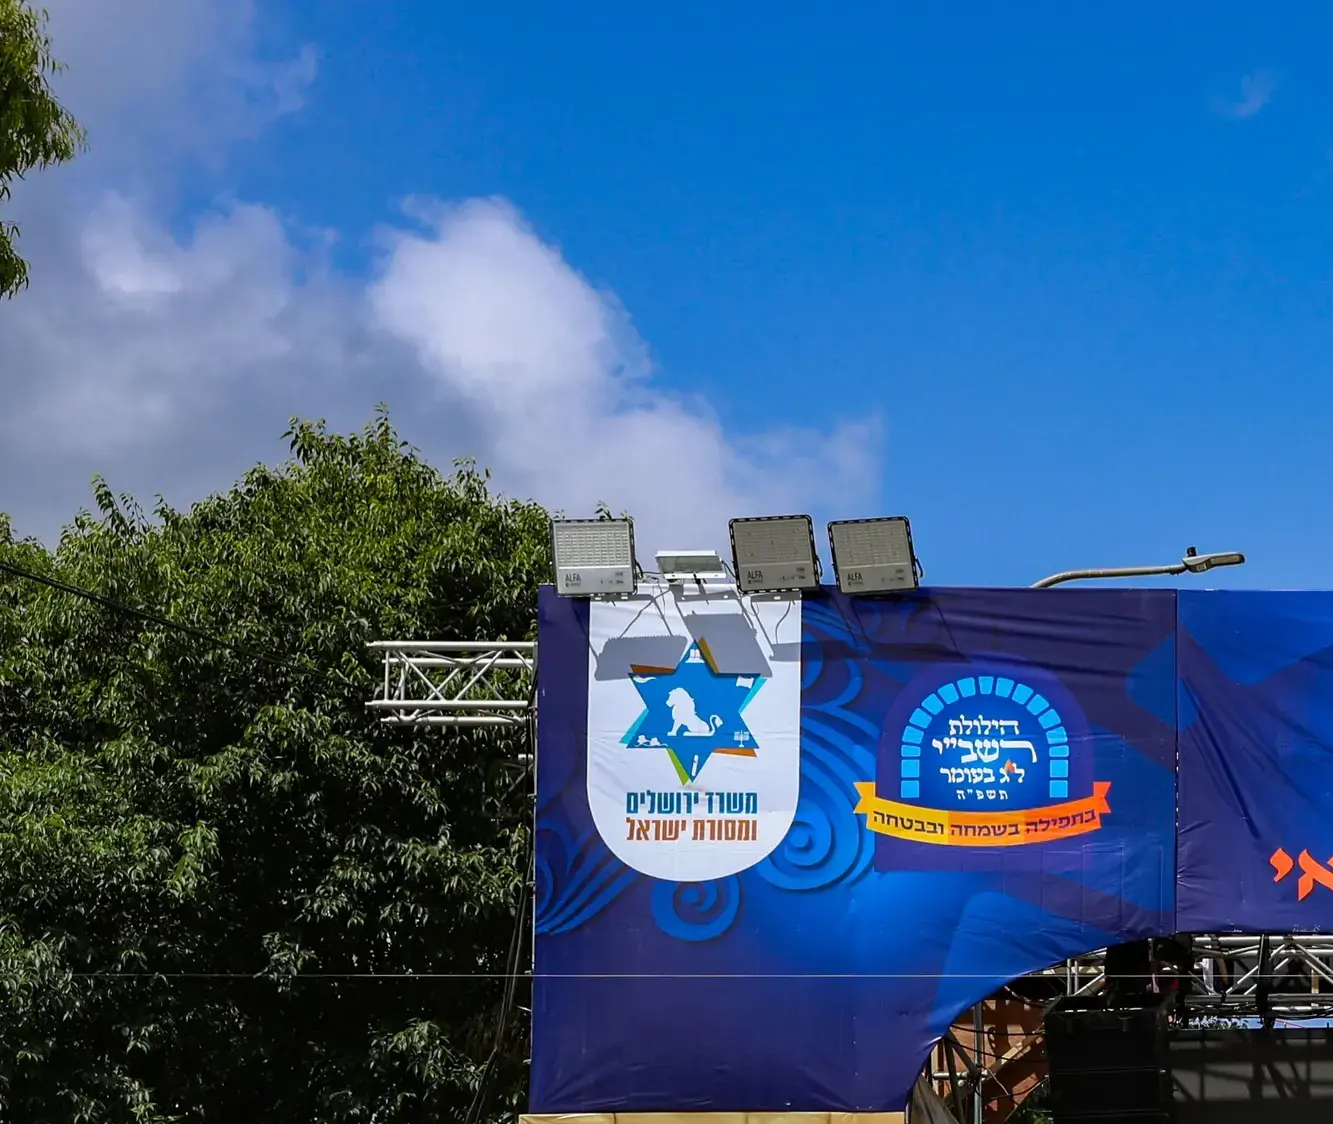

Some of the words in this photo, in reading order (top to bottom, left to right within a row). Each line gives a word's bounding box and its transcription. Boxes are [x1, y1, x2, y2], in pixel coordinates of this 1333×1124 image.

[949, 714, 1019, 738] הילולת
[939, 766, 995, 784] בעומר
[626, 790, 700, 815] ירושלים
[704, 791, 758, 814] משרד
[626, 817, 687, 843] ישראל
[691, 817, 757, 842] ומסורת
[872, 808, 944, 836] ובבטחה
[951, 820, 1020, 838] בשמחה
[1024, 807, 1097, 836] בתפילה
